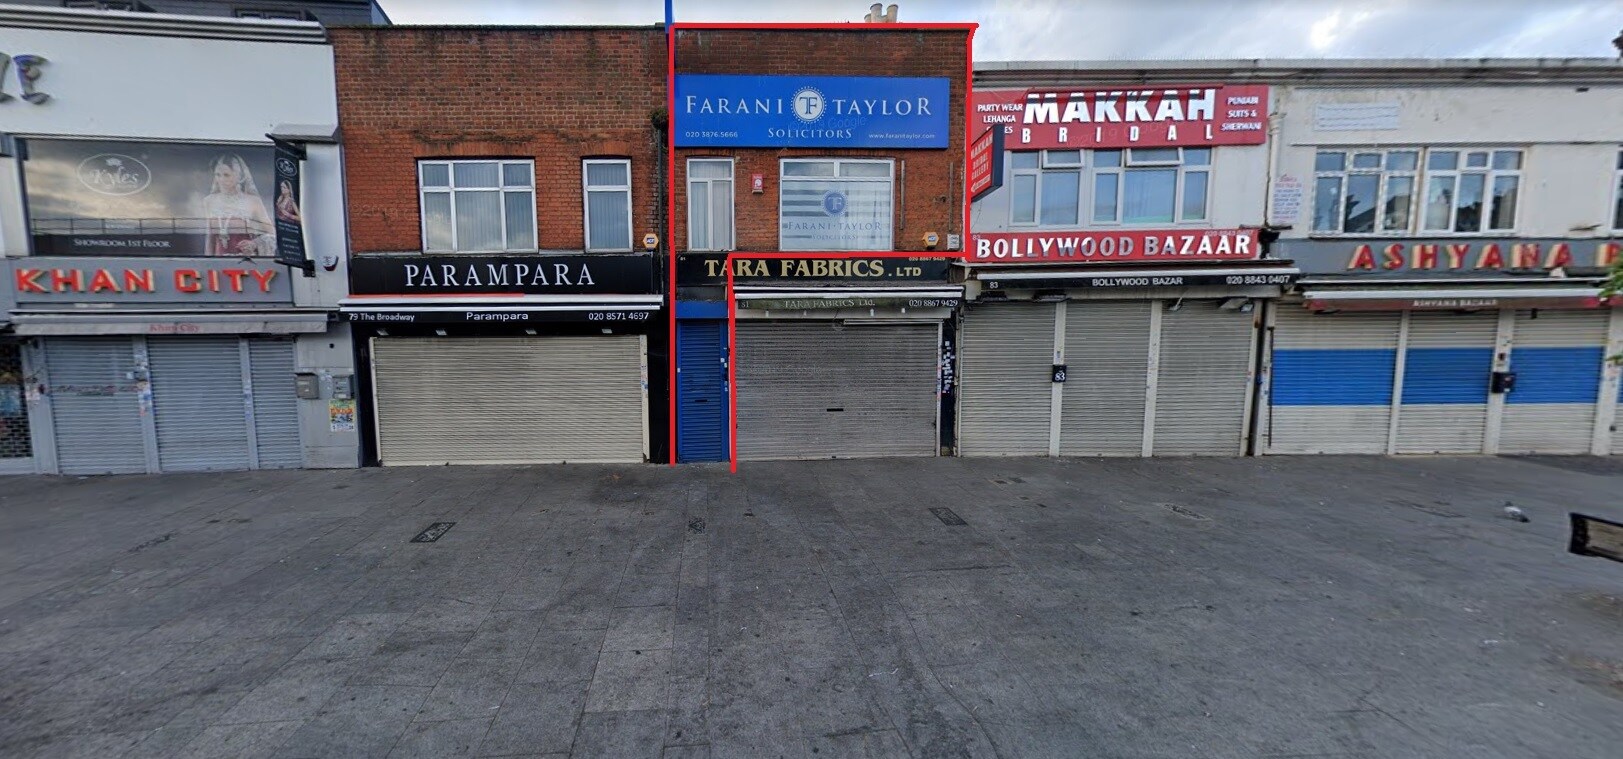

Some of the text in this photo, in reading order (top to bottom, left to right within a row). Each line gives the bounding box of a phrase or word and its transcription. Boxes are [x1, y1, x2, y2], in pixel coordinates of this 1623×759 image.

[686, 95, 783, 114] FARANI
[832, 97, 932, 116] TAYLOR
[977, 103, 1023, 112] PARTY WEAR
[1023, 88, 1216, 123] MAKKAH
[1228, 109, 1249, 118] SUITS
[983, 115, 1016, 123] LEHANGA
[768, 127, 852, 138] SOLICITORS
[1021, 123, 1213, 143] BRIDAL
[788, 221, 881, 231] FARANI TAYLOR
[976, 234, 1251, 258] BOLLYWOOD BAZAAR
[1347, 242, 1574, 270] ASHYANA
[780, 259, 885, 277] FABRICS
[404, 262, 595, 287] PARAMPARA
[15, 268, 278, 293] KHAN CITY
[989, 281, 999, 289] 83
[1092, 277, 1183, 287] BOLLYWOOD BAZAR
[1226, 276, 1243, 285] 020
[784, 300, 809, 309] TARA
[813, 299, 855, 309] FABRICS
[908, 299, 958, 307] 020 8867 9429
[348, 313, 415, 323] 79 The Broadway
[466, 312, 529, 321] Parampara
[588, 312, 649, 321] 020 8571 4697
[1055, 371, 1065, 381] 83
